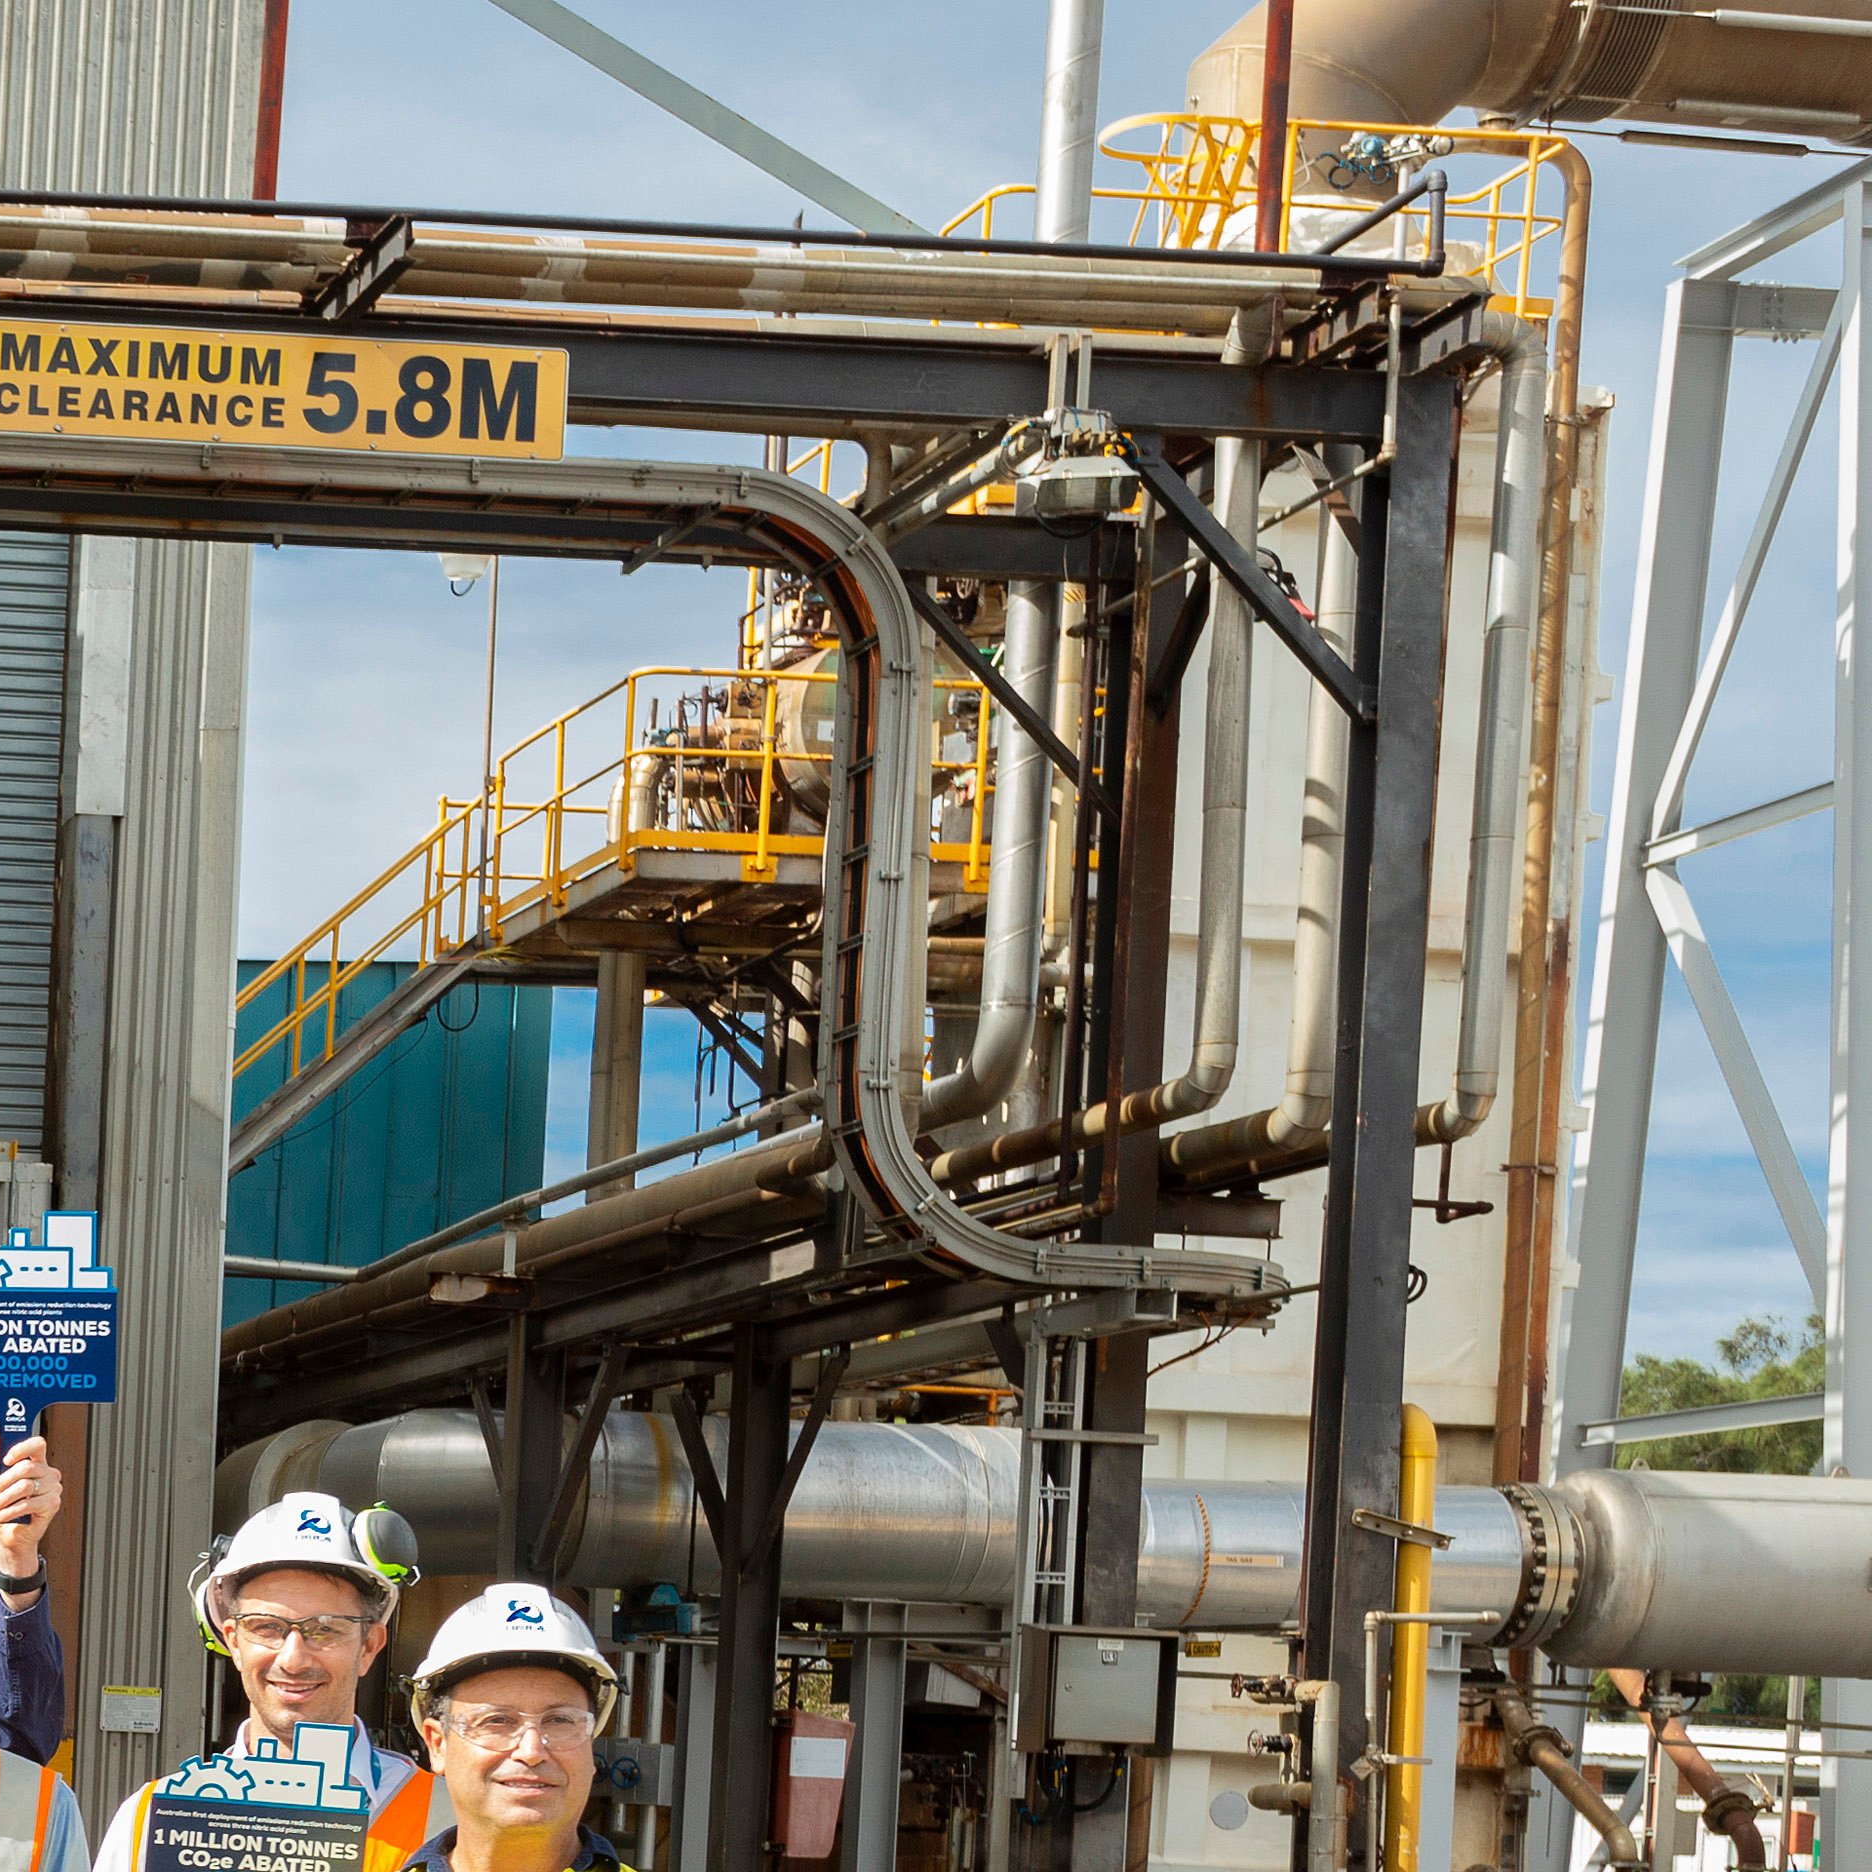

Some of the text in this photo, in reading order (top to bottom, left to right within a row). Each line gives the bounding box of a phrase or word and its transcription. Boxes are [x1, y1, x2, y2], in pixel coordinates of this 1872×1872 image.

[0, 331, 281, 388] MAXIMUM
[301, 351, 539, 443] 5.8M
[26, 1319, 111, 1337] TONNES
[2, 1337, 87, 1354] ABATED
[1192, 1643, 1221, 1655] CAUTION
